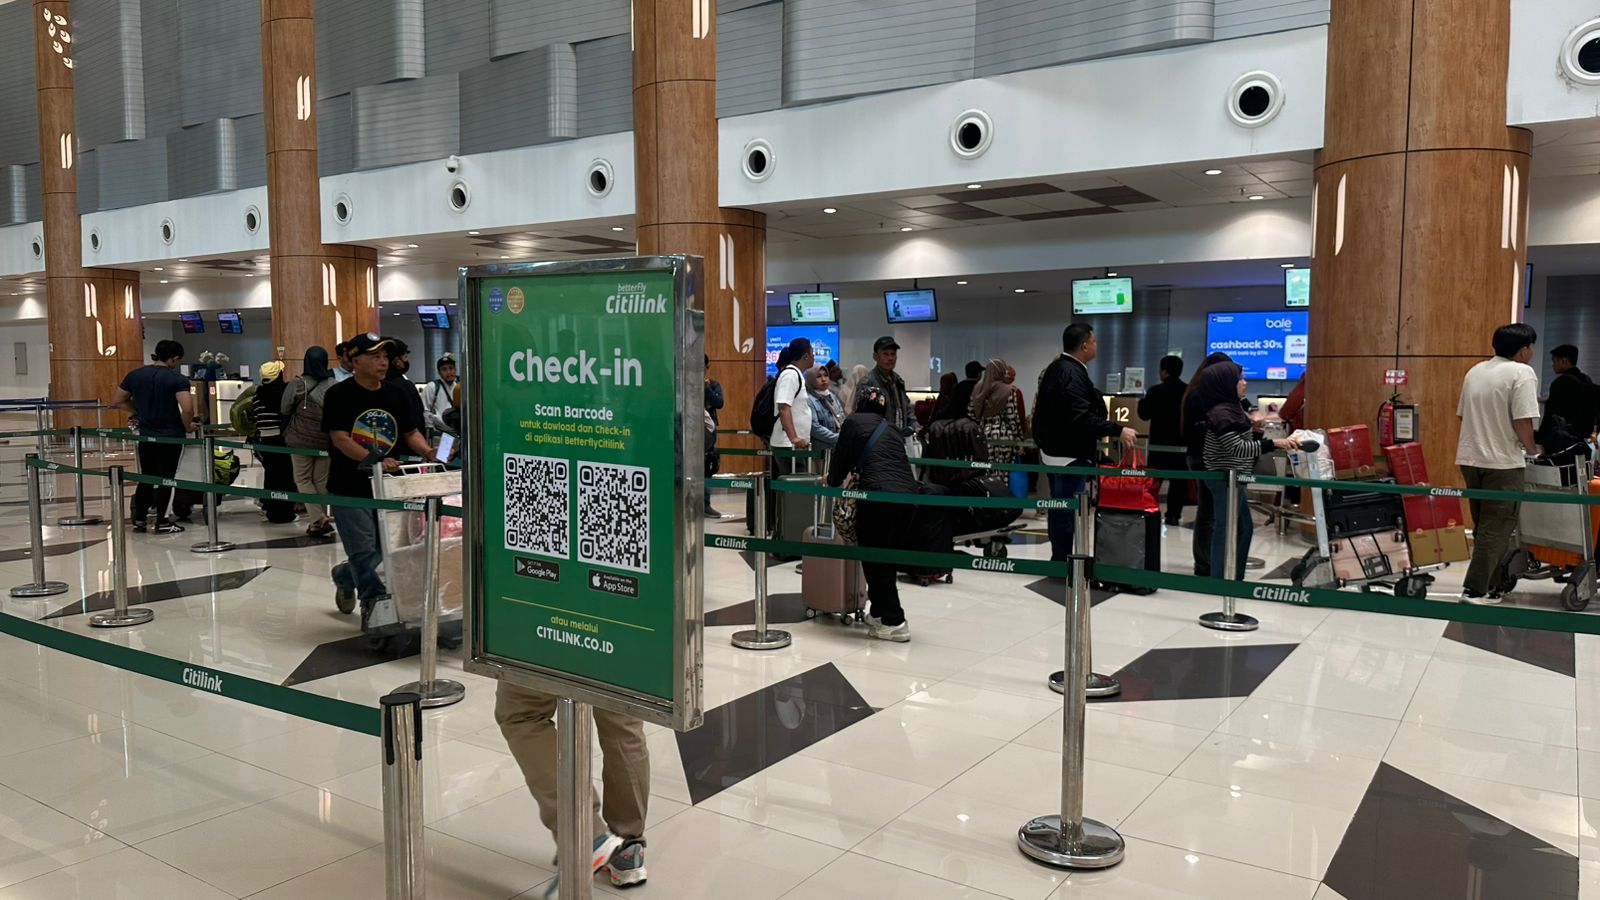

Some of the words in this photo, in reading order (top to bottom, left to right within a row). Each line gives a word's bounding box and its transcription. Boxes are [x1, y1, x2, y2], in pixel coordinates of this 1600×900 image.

[606, 294, 667, 313] Citilink
[1210, 340, 1261, 349] cashback
[1263, 340, 1283, 349] 30%
[509, 347, 642, 386] Check-in
[535, 403, 561, 416] Scan
[564, 405, 613, 420] Barcode
[1115, 407, 1130, 421] 12
[520, 420, 541, 430] untuk
[543, 422, 575, 432] dowload
[577, 424, 593, 433] dan
[595, 425, 630, 437] Check-in
[525, 432, 532, 441] di
[534, 433, 563, 445] aplikasi
[970, 461, 992, 469] Citilink
[1121, 469, 1146, 477] Citilink
[730, 481, 752, 489] Citilink
[1430, 487, 1463, 497] Citilink
[841, 490, 868, 499] Citilink
[1036, 500, 1068, 509] Citilink
[714, 537, 748, 549] Citilink
[971, 558, 1015, 572] Citilink
[527, 565, 546, 577] Google
[546, 568, 557, 580] Play
[603, 580, 617, 592] App
[617, 582, 635, 594] Store
[1253, 586, 1310, 603] Citilink
[550, 616, 569, 627] atau
[570, 620, 599, 633] melalui
[536, 625, 614, 654] CITILINK.CO.ID
[182, 667, 223, 693] Citilink
